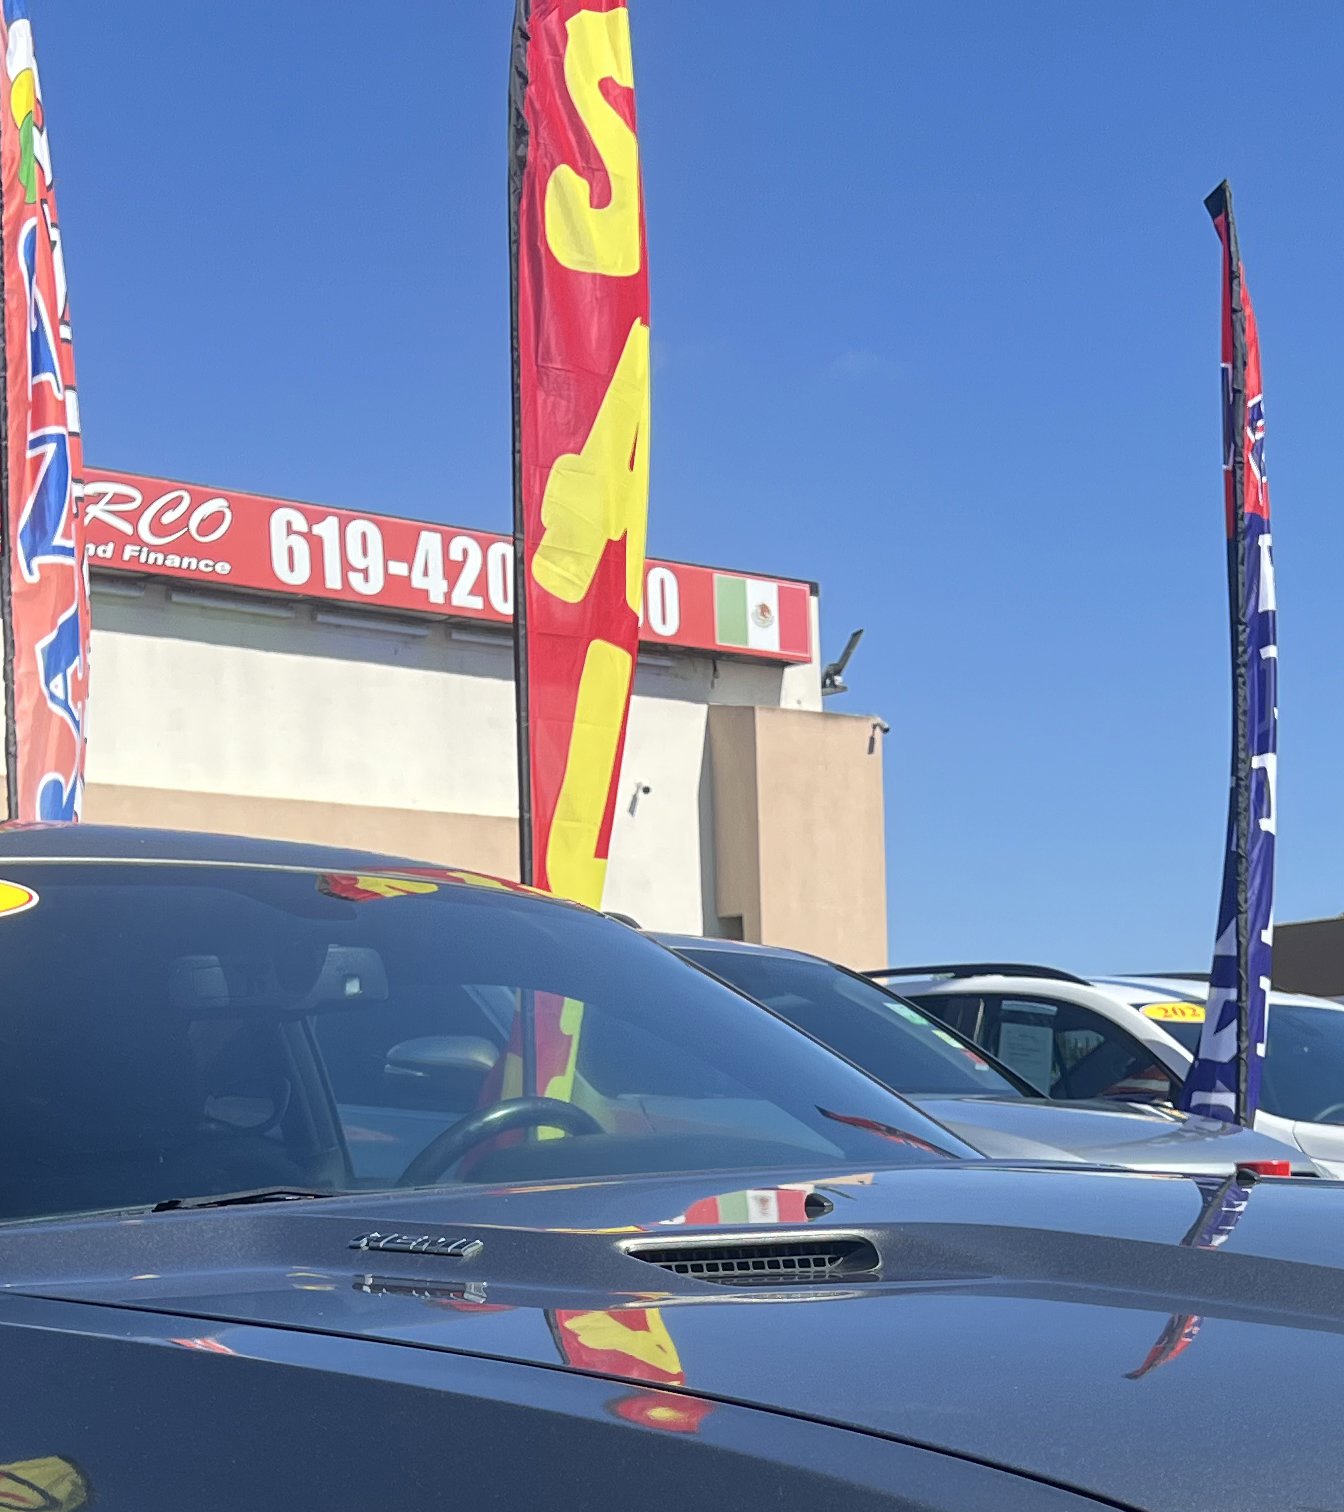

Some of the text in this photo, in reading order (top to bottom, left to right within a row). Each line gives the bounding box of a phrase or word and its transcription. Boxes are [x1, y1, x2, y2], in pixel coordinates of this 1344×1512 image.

[533, 8, 650, 900] SAL
[122, 544, 232, 576] Finance
[1157, 1006, 1201, 1018] 202
